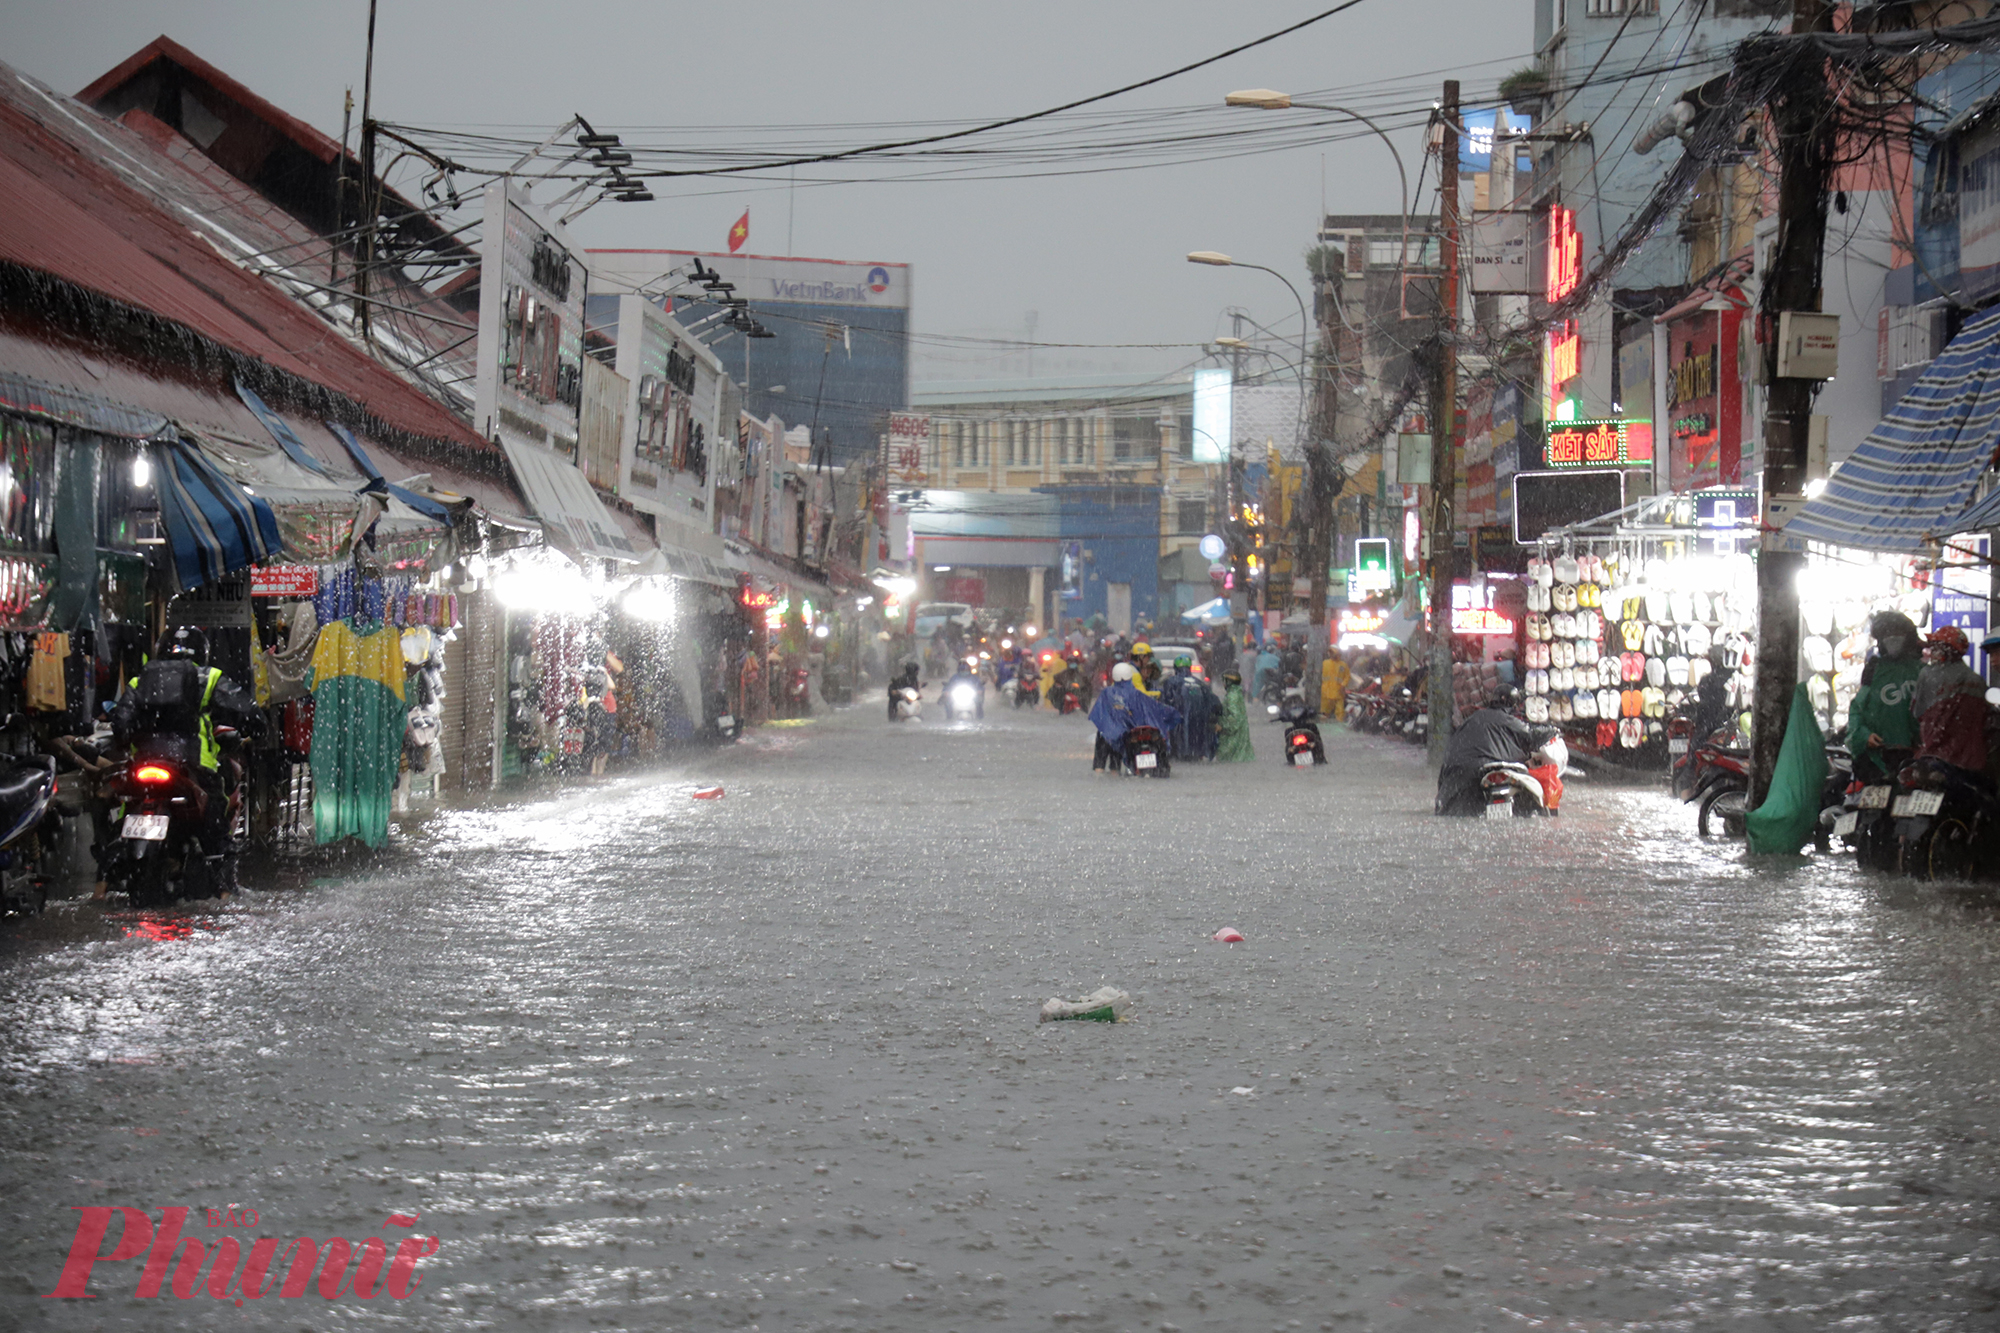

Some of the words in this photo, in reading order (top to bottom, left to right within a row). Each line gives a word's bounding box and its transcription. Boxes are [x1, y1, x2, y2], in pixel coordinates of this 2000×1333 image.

[772, 278, 867, 302] VietinBank
[1550, 428, 1583, 461] KÉT
[1586, 422, 1619, 461] SẮT
